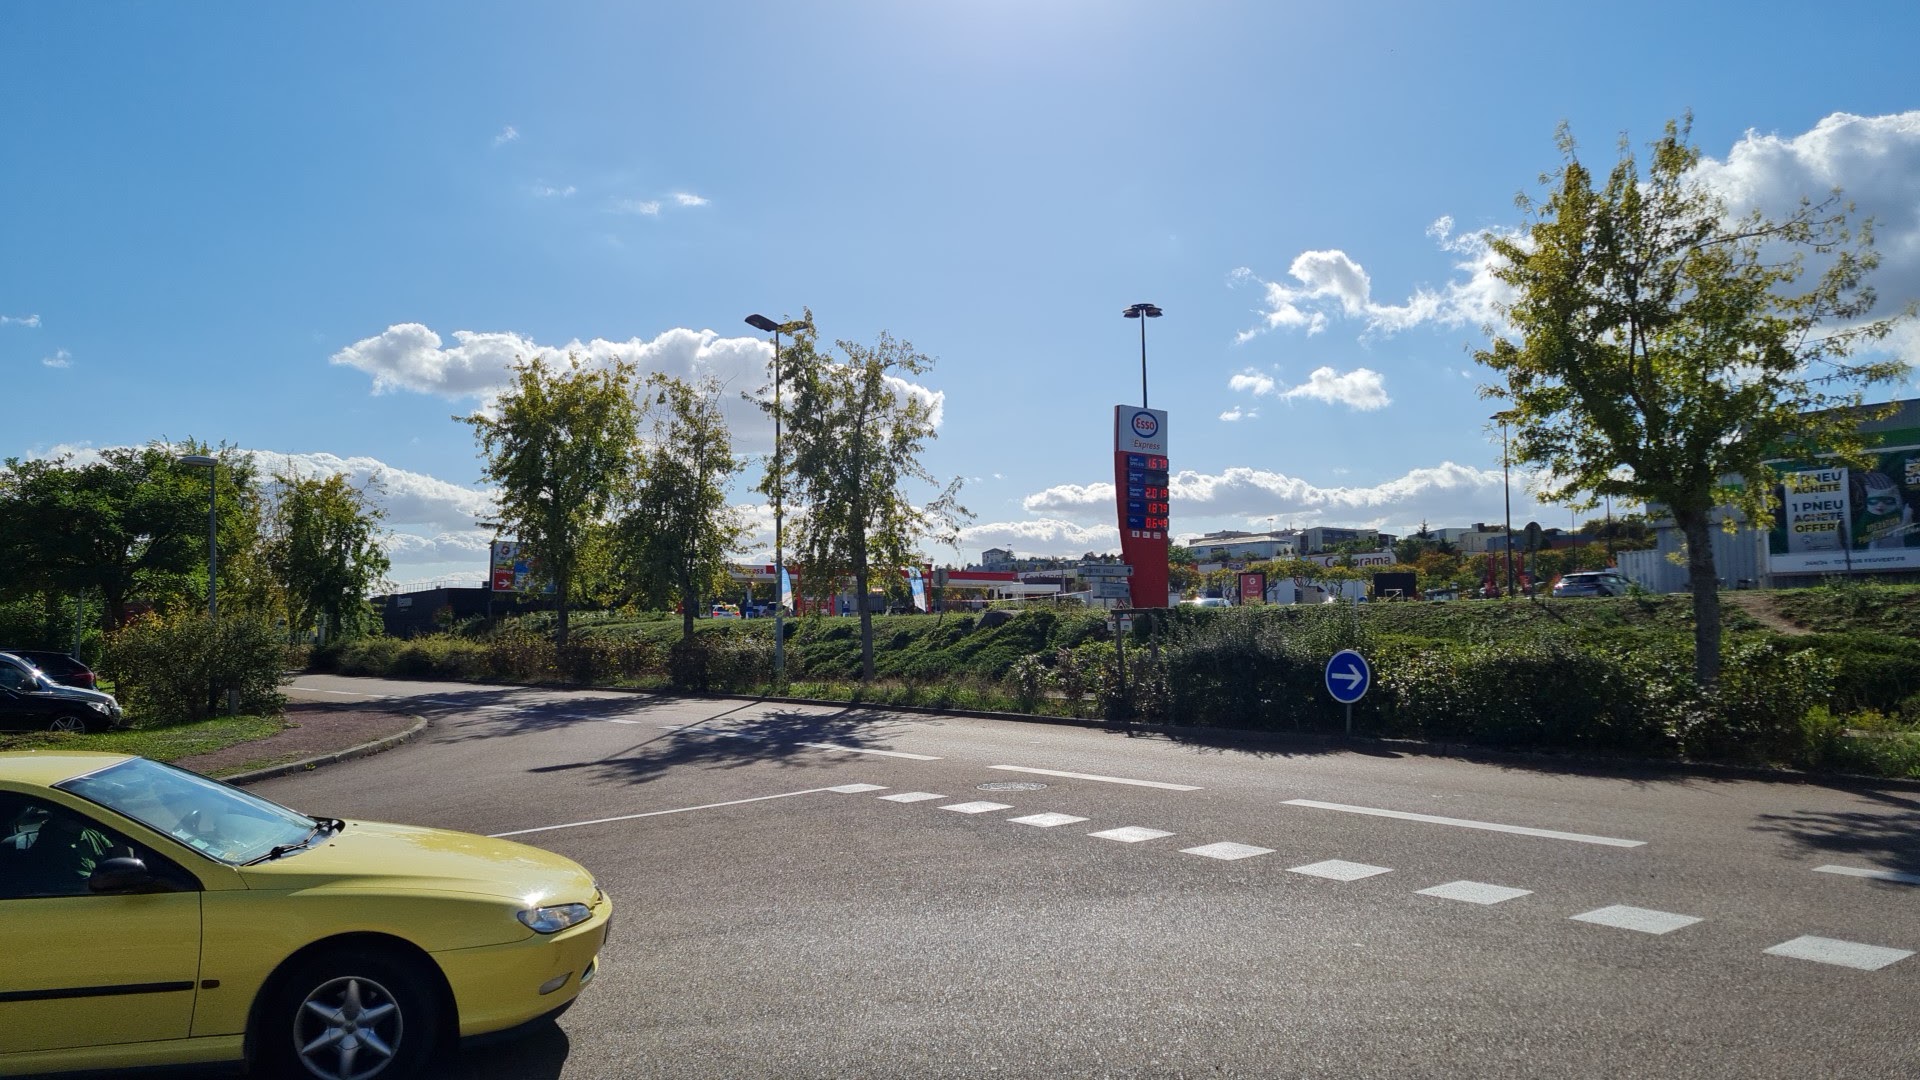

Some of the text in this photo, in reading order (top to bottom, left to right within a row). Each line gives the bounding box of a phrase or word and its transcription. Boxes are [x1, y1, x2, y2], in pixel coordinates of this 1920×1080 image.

[1136, 418, 1154, 430] Esso
[1134, 440, 1160, 450] Express
[1792, 500, 1844, 512] 1 PNEU
[1796, 522, 1837, 532] OFFER
